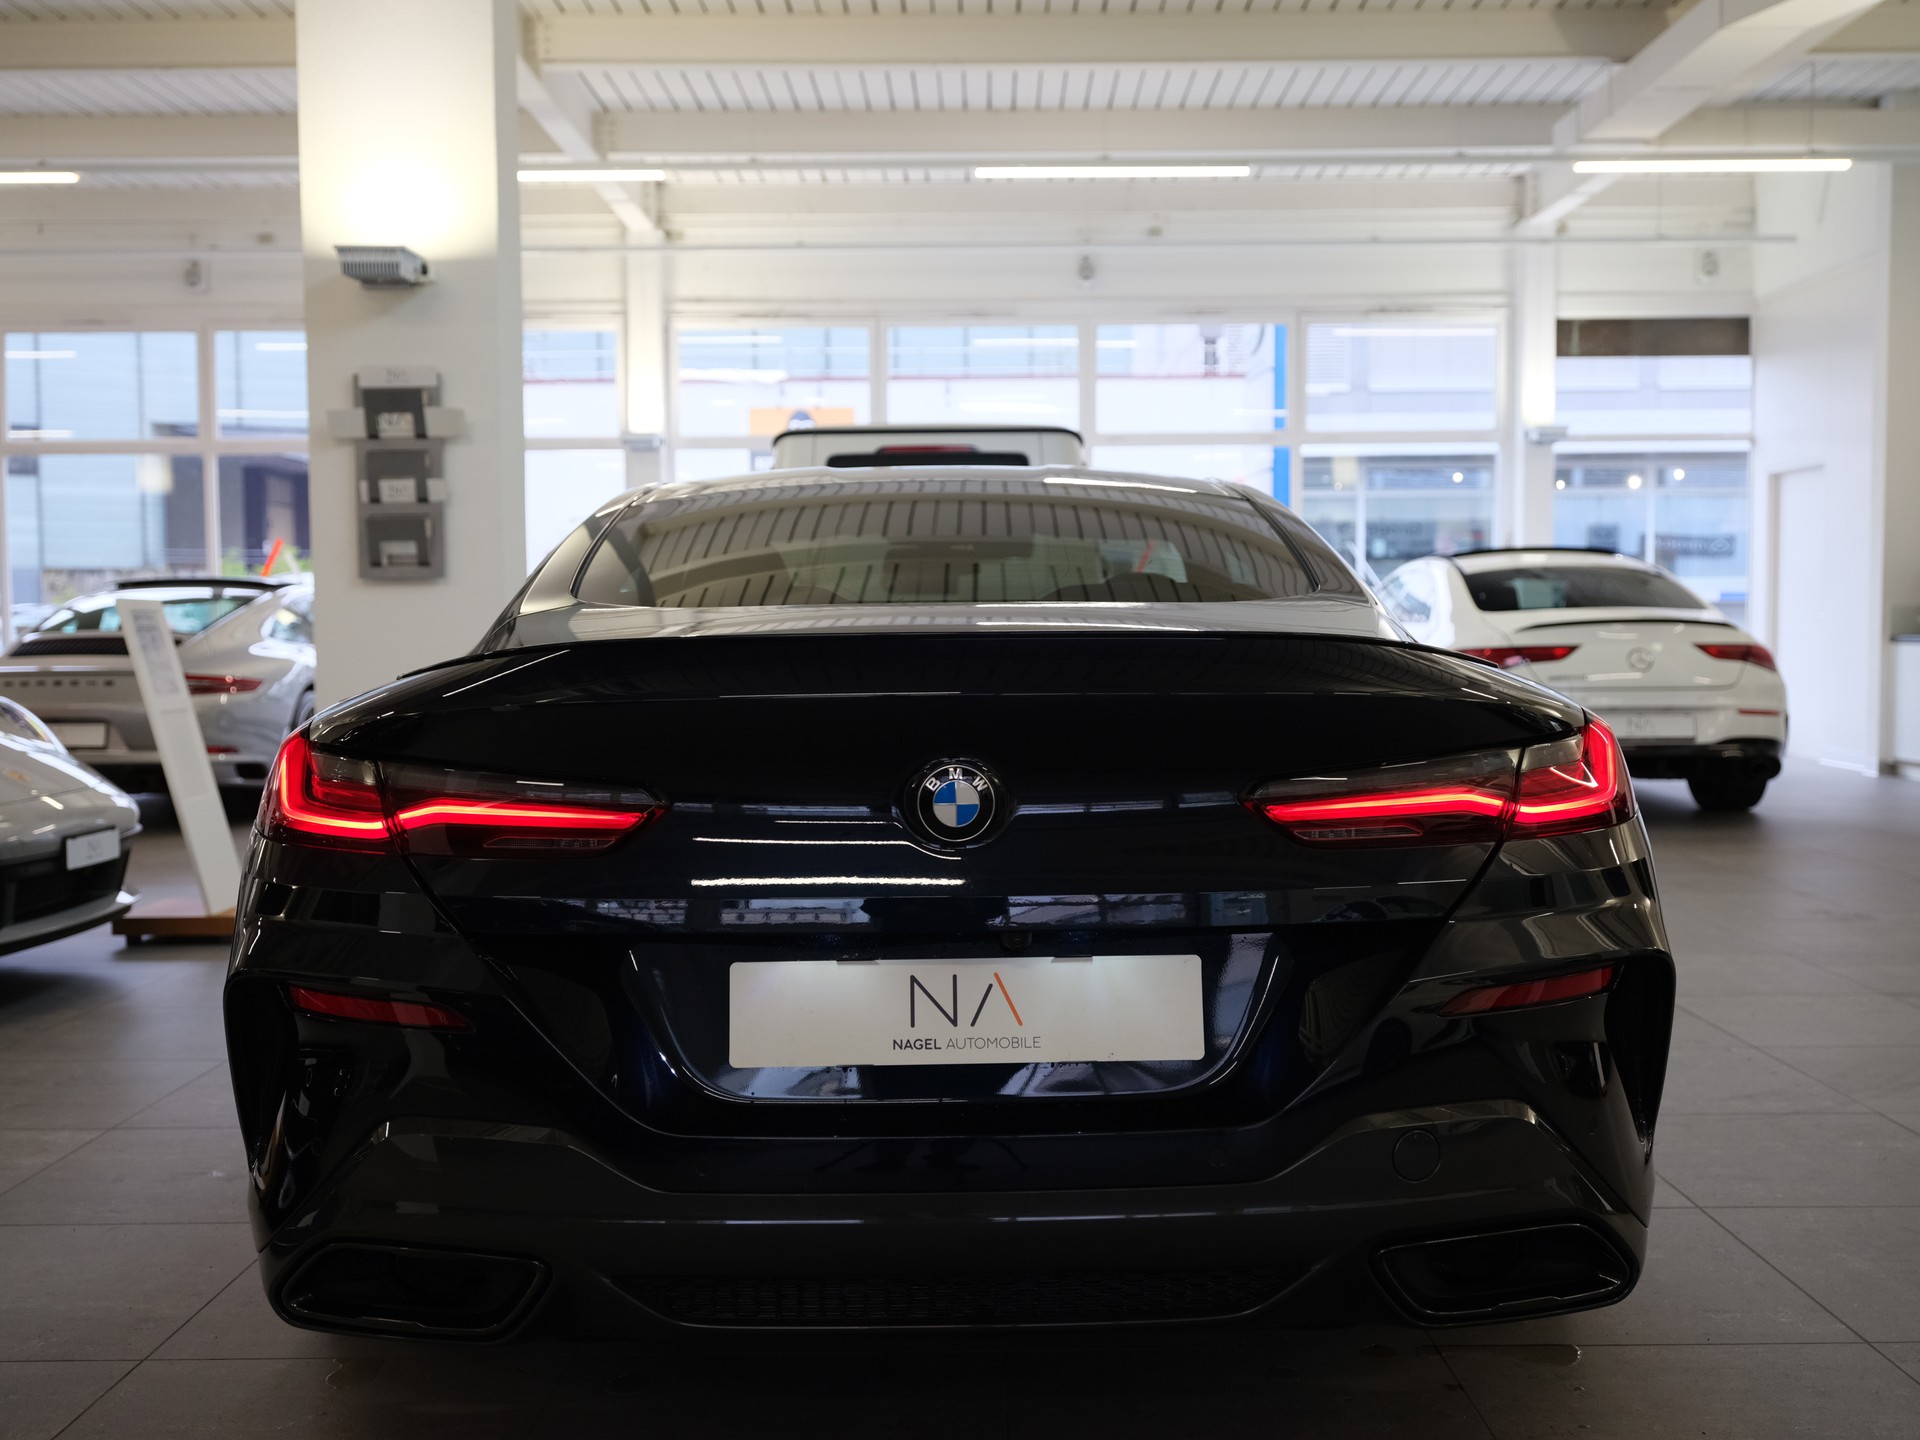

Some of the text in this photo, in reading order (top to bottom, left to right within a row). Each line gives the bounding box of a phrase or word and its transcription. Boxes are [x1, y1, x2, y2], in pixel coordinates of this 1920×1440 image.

[925, 767, 988, 792] BMW
[892, 1036, 1041, 1050] NAGEL AUTOMOBILE
